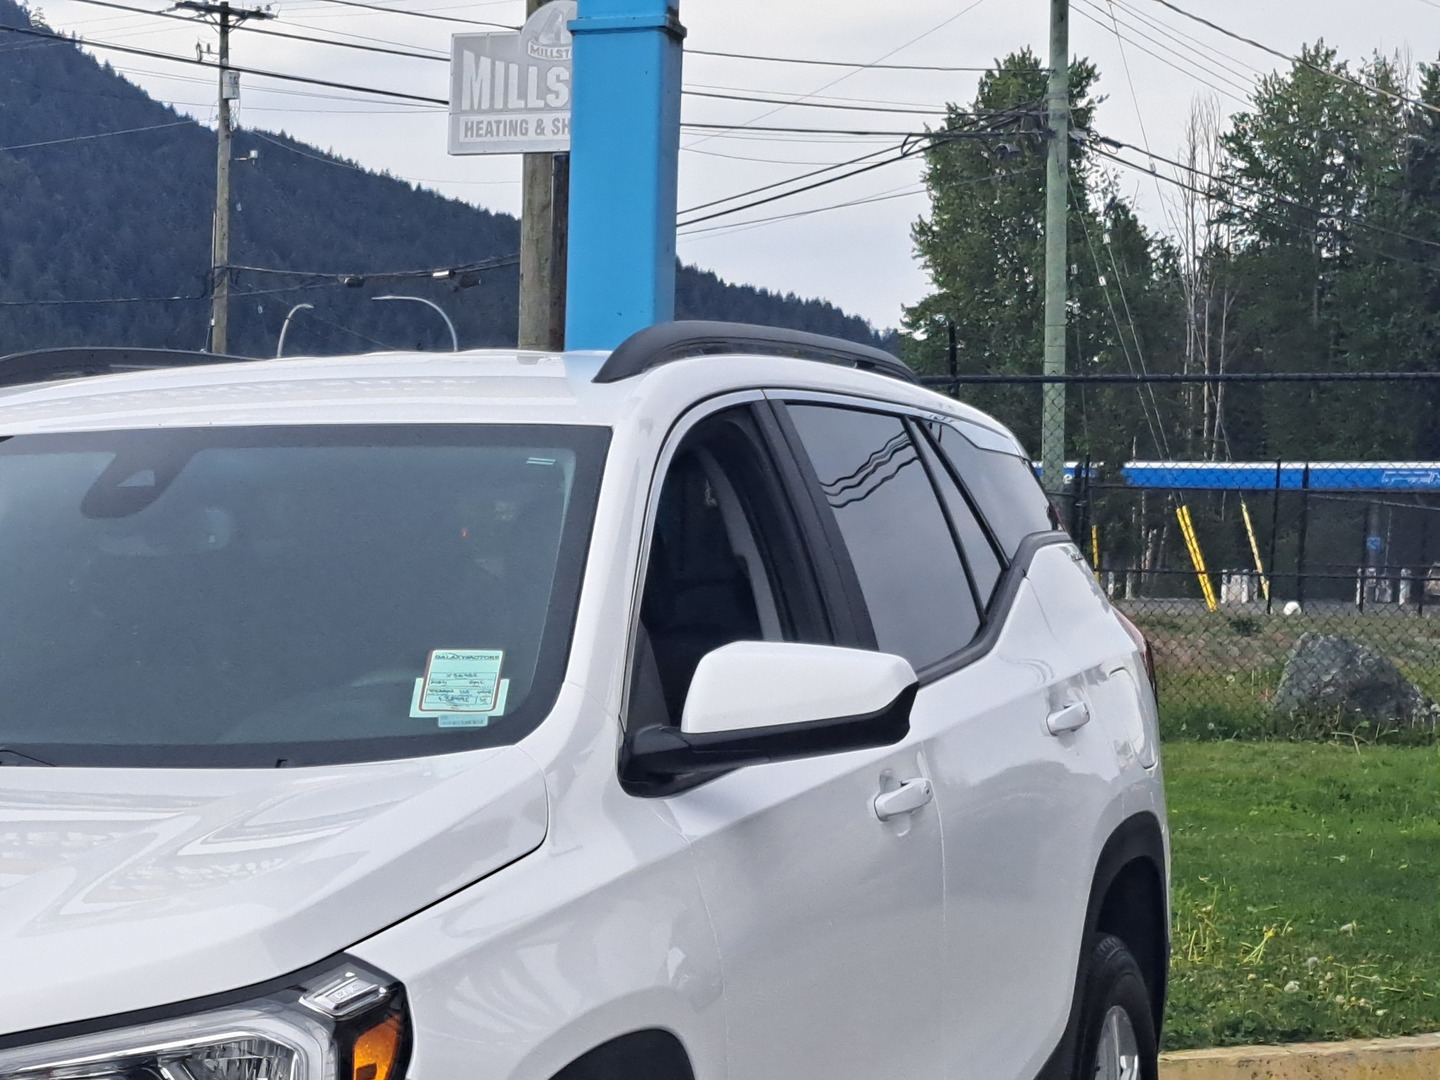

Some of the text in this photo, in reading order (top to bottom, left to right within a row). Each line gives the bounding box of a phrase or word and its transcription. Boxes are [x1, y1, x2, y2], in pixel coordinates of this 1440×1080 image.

[461, 49, 570, 111] MILLS
[464, 117, 570, 138] HEATING & SH
